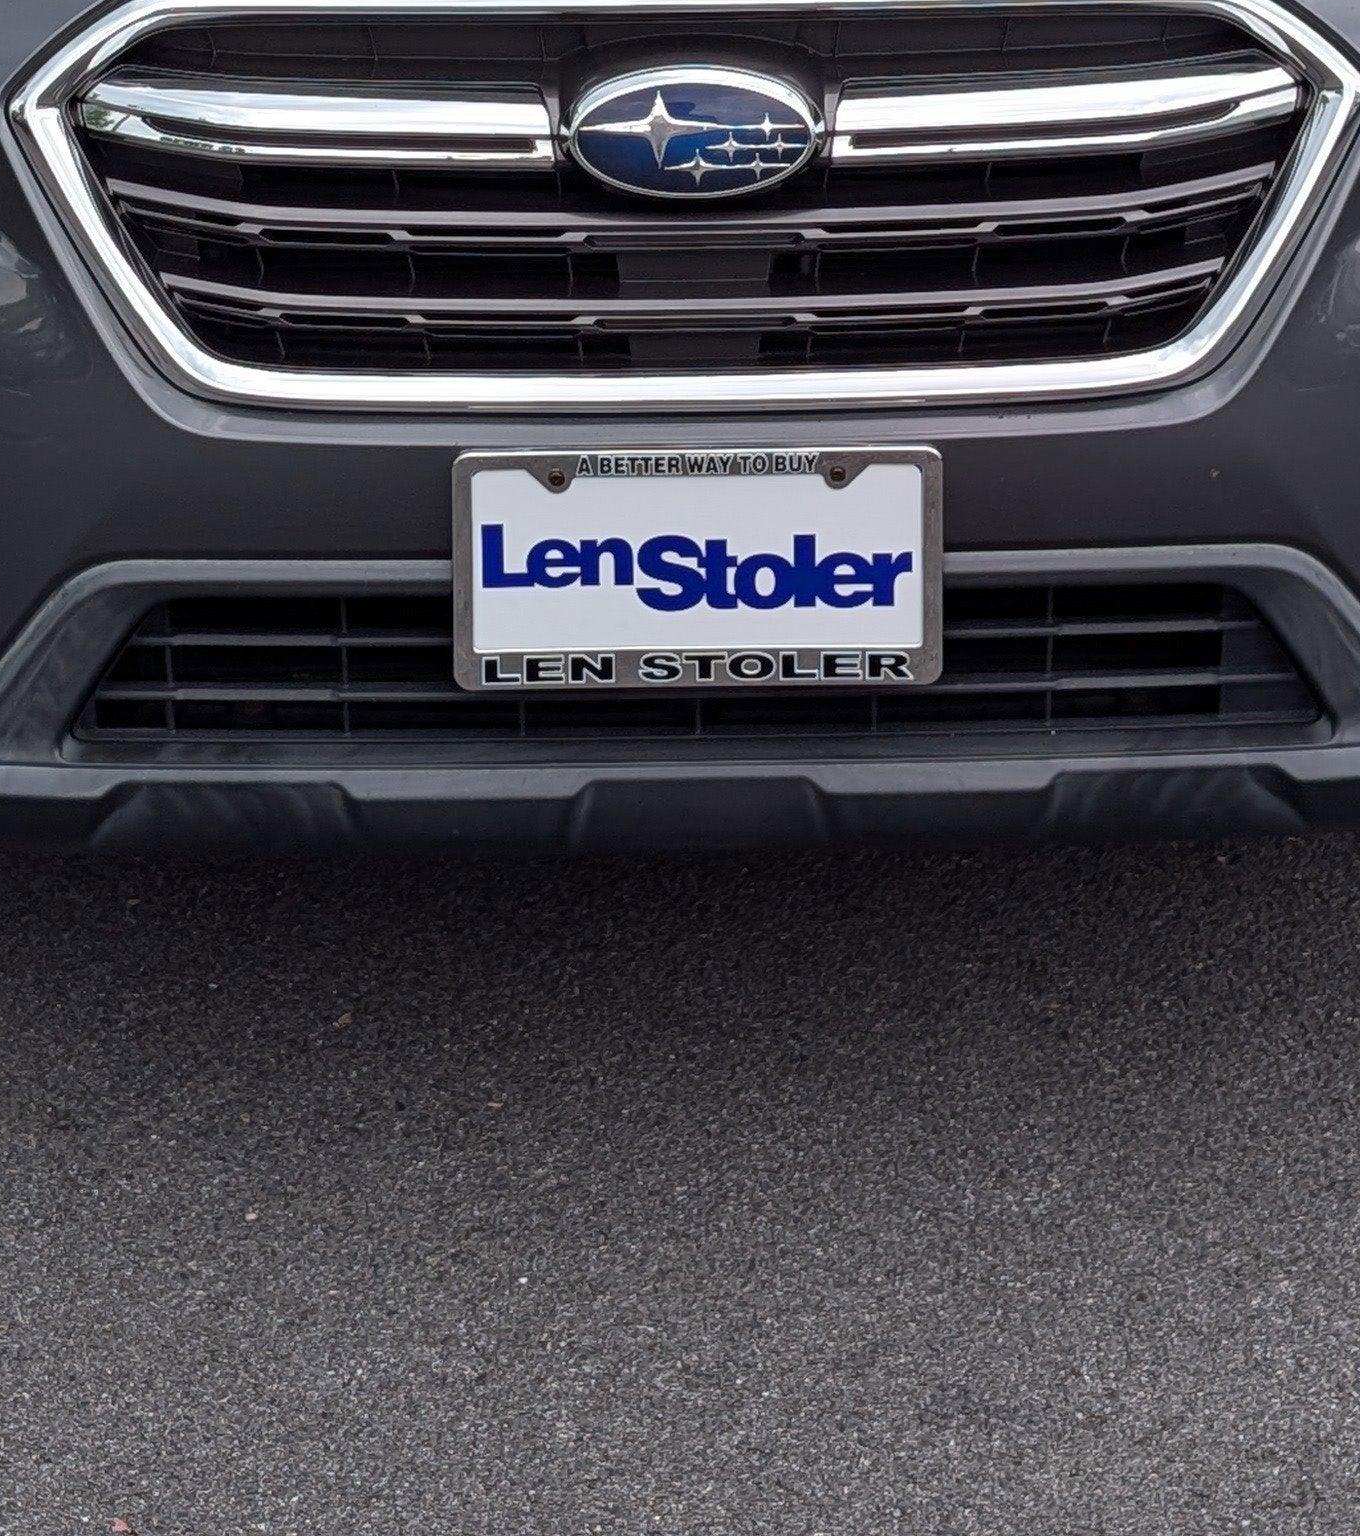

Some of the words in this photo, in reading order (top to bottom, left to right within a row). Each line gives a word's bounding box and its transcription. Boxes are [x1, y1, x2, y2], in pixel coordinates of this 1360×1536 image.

[576, 455, 593, 476] A
[598, 455, 681, 476] BETTER
[685, 453, 734, 475] WAY
[738, 453, 768, 474] TO
[773, 452, 820, 474] BUY
[482, 654, 617, 685] LEN
[639, 651, 915, 683] STOLER
